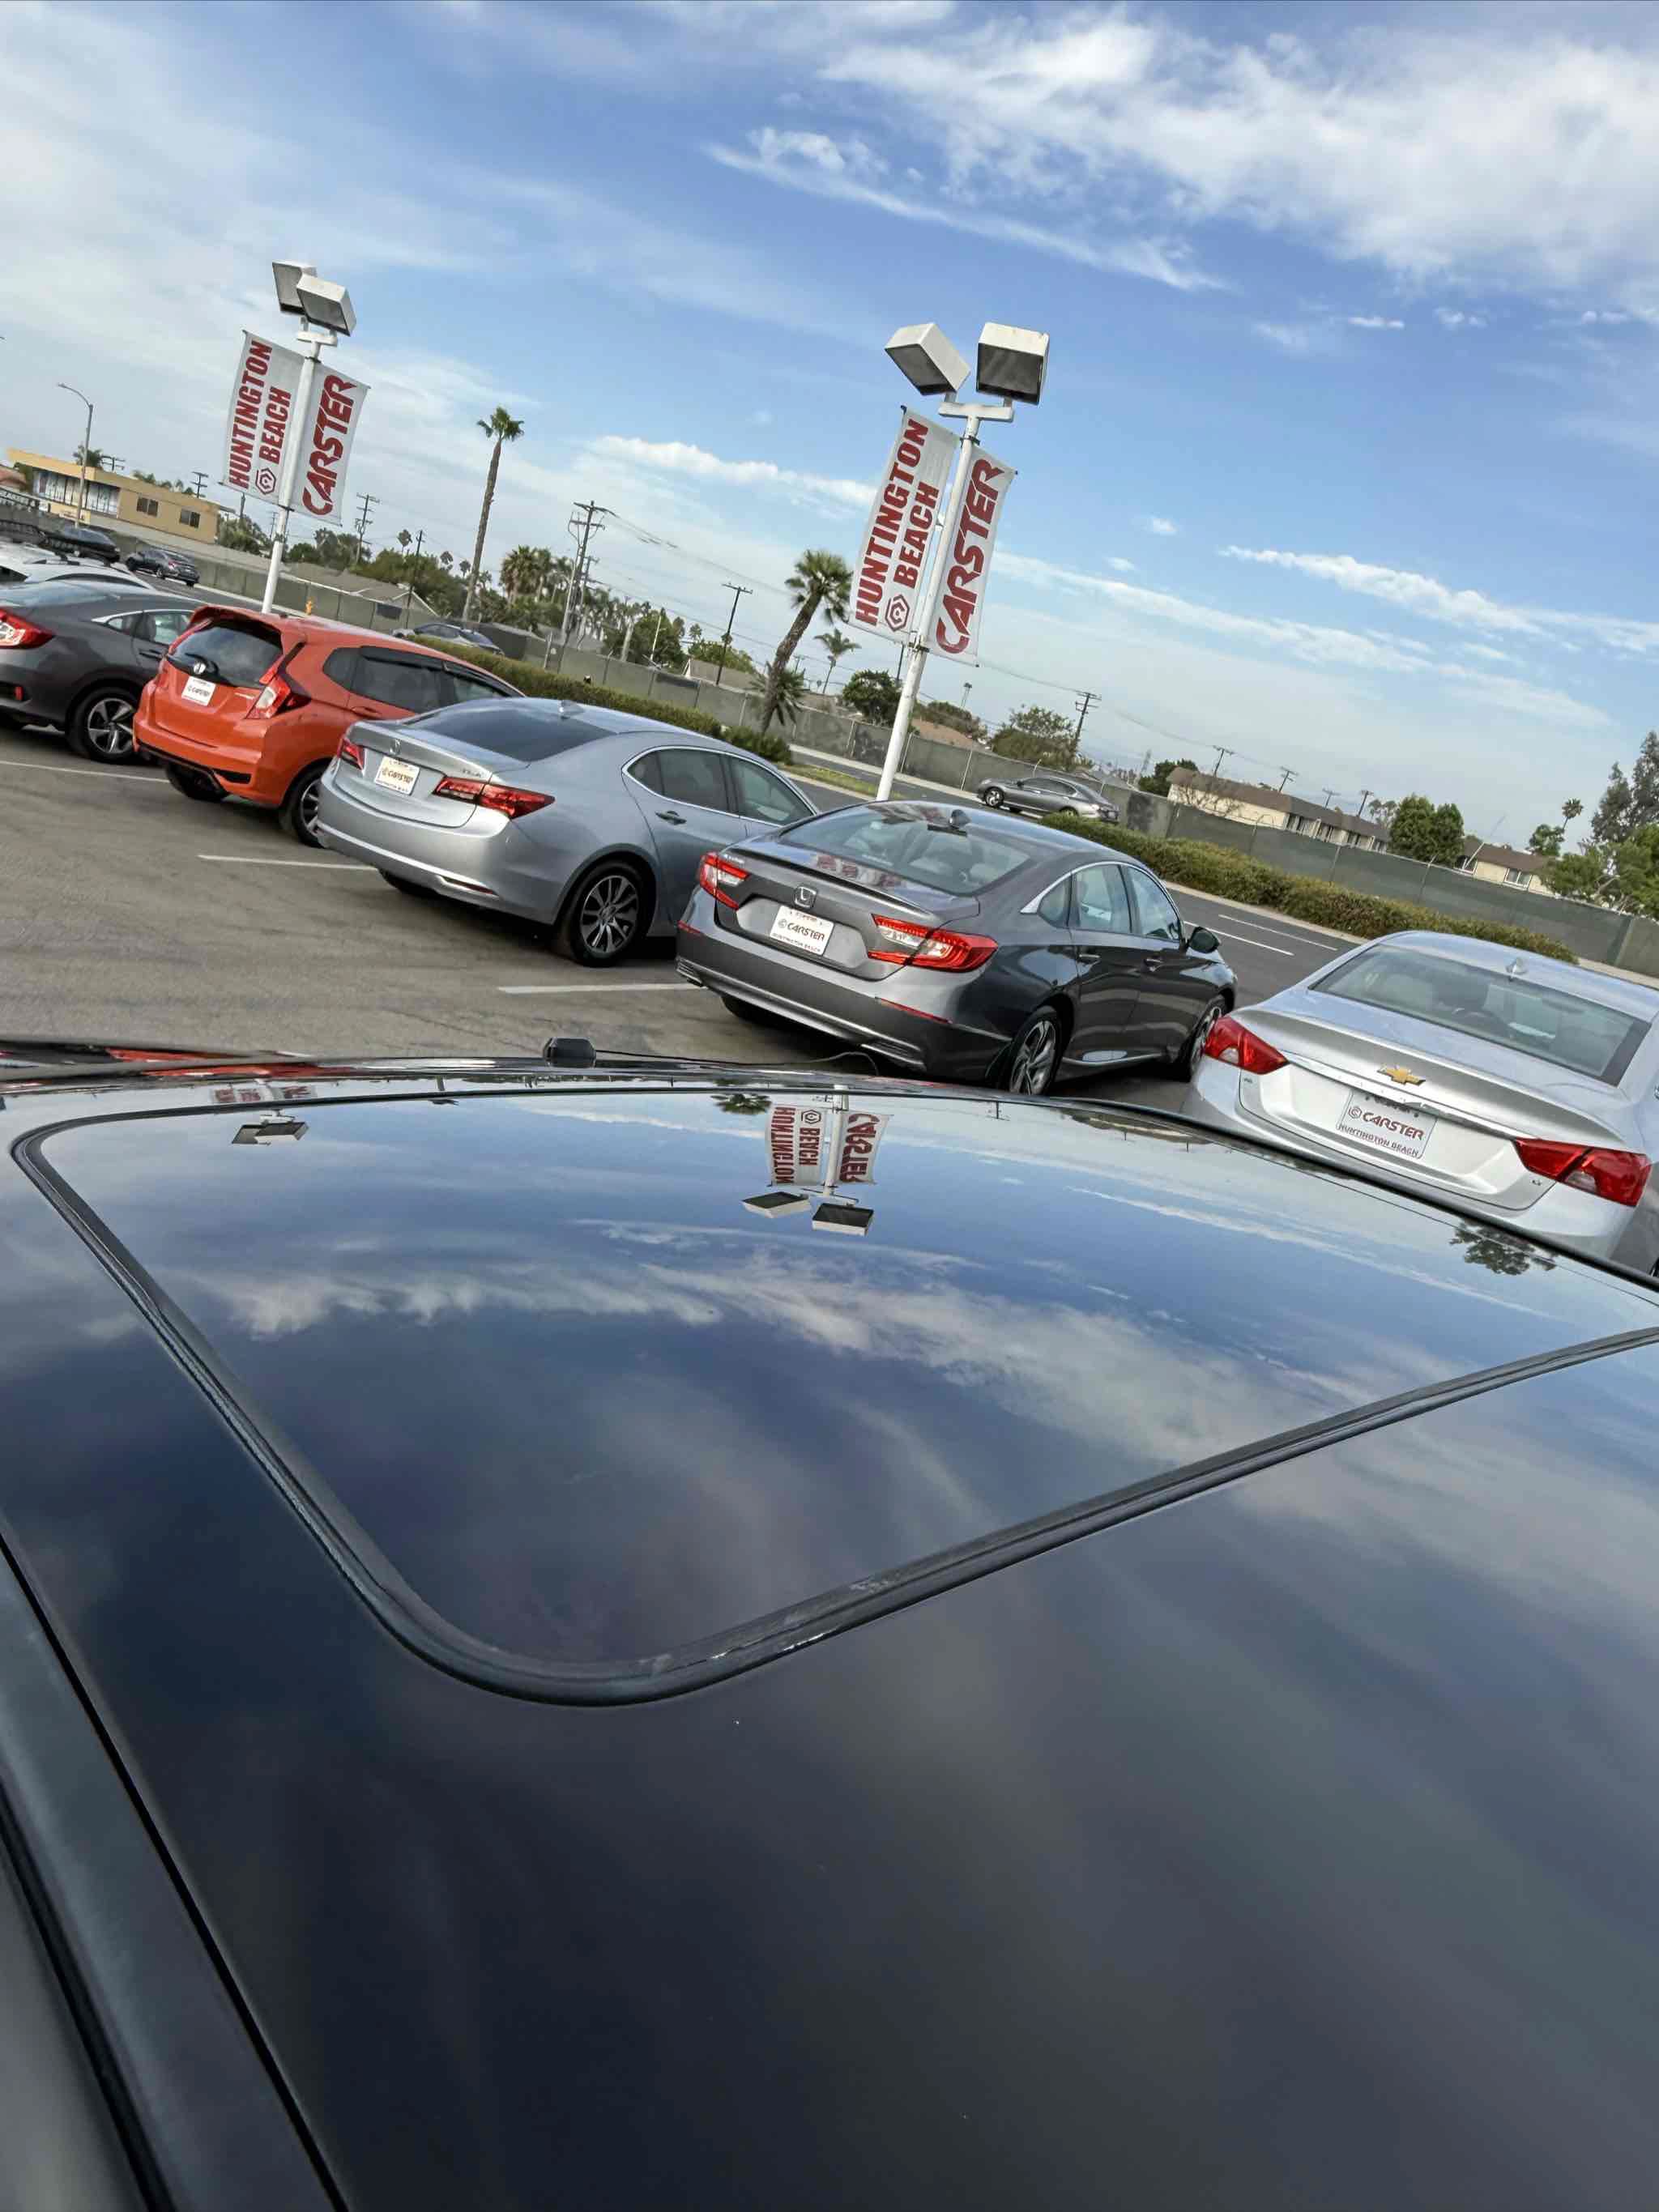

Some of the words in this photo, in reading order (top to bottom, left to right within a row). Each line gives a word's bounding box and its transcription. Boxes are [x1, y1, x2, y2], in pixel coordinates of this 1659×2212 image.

[229, 340, 272, 489] HUNTINGTON
[259, 386, 292, 464] BEACH
[302, 374, 356, 515] CARSTER
[855, 419, 928, 625] HUNTINGTON
[893, 481, 939, 589] BEACH
[936, 458, 1004, 654] CARSTER
[787, 923, 825, 941] CARSTER
[1363, 1112, 1424, 1140] CARSTER
